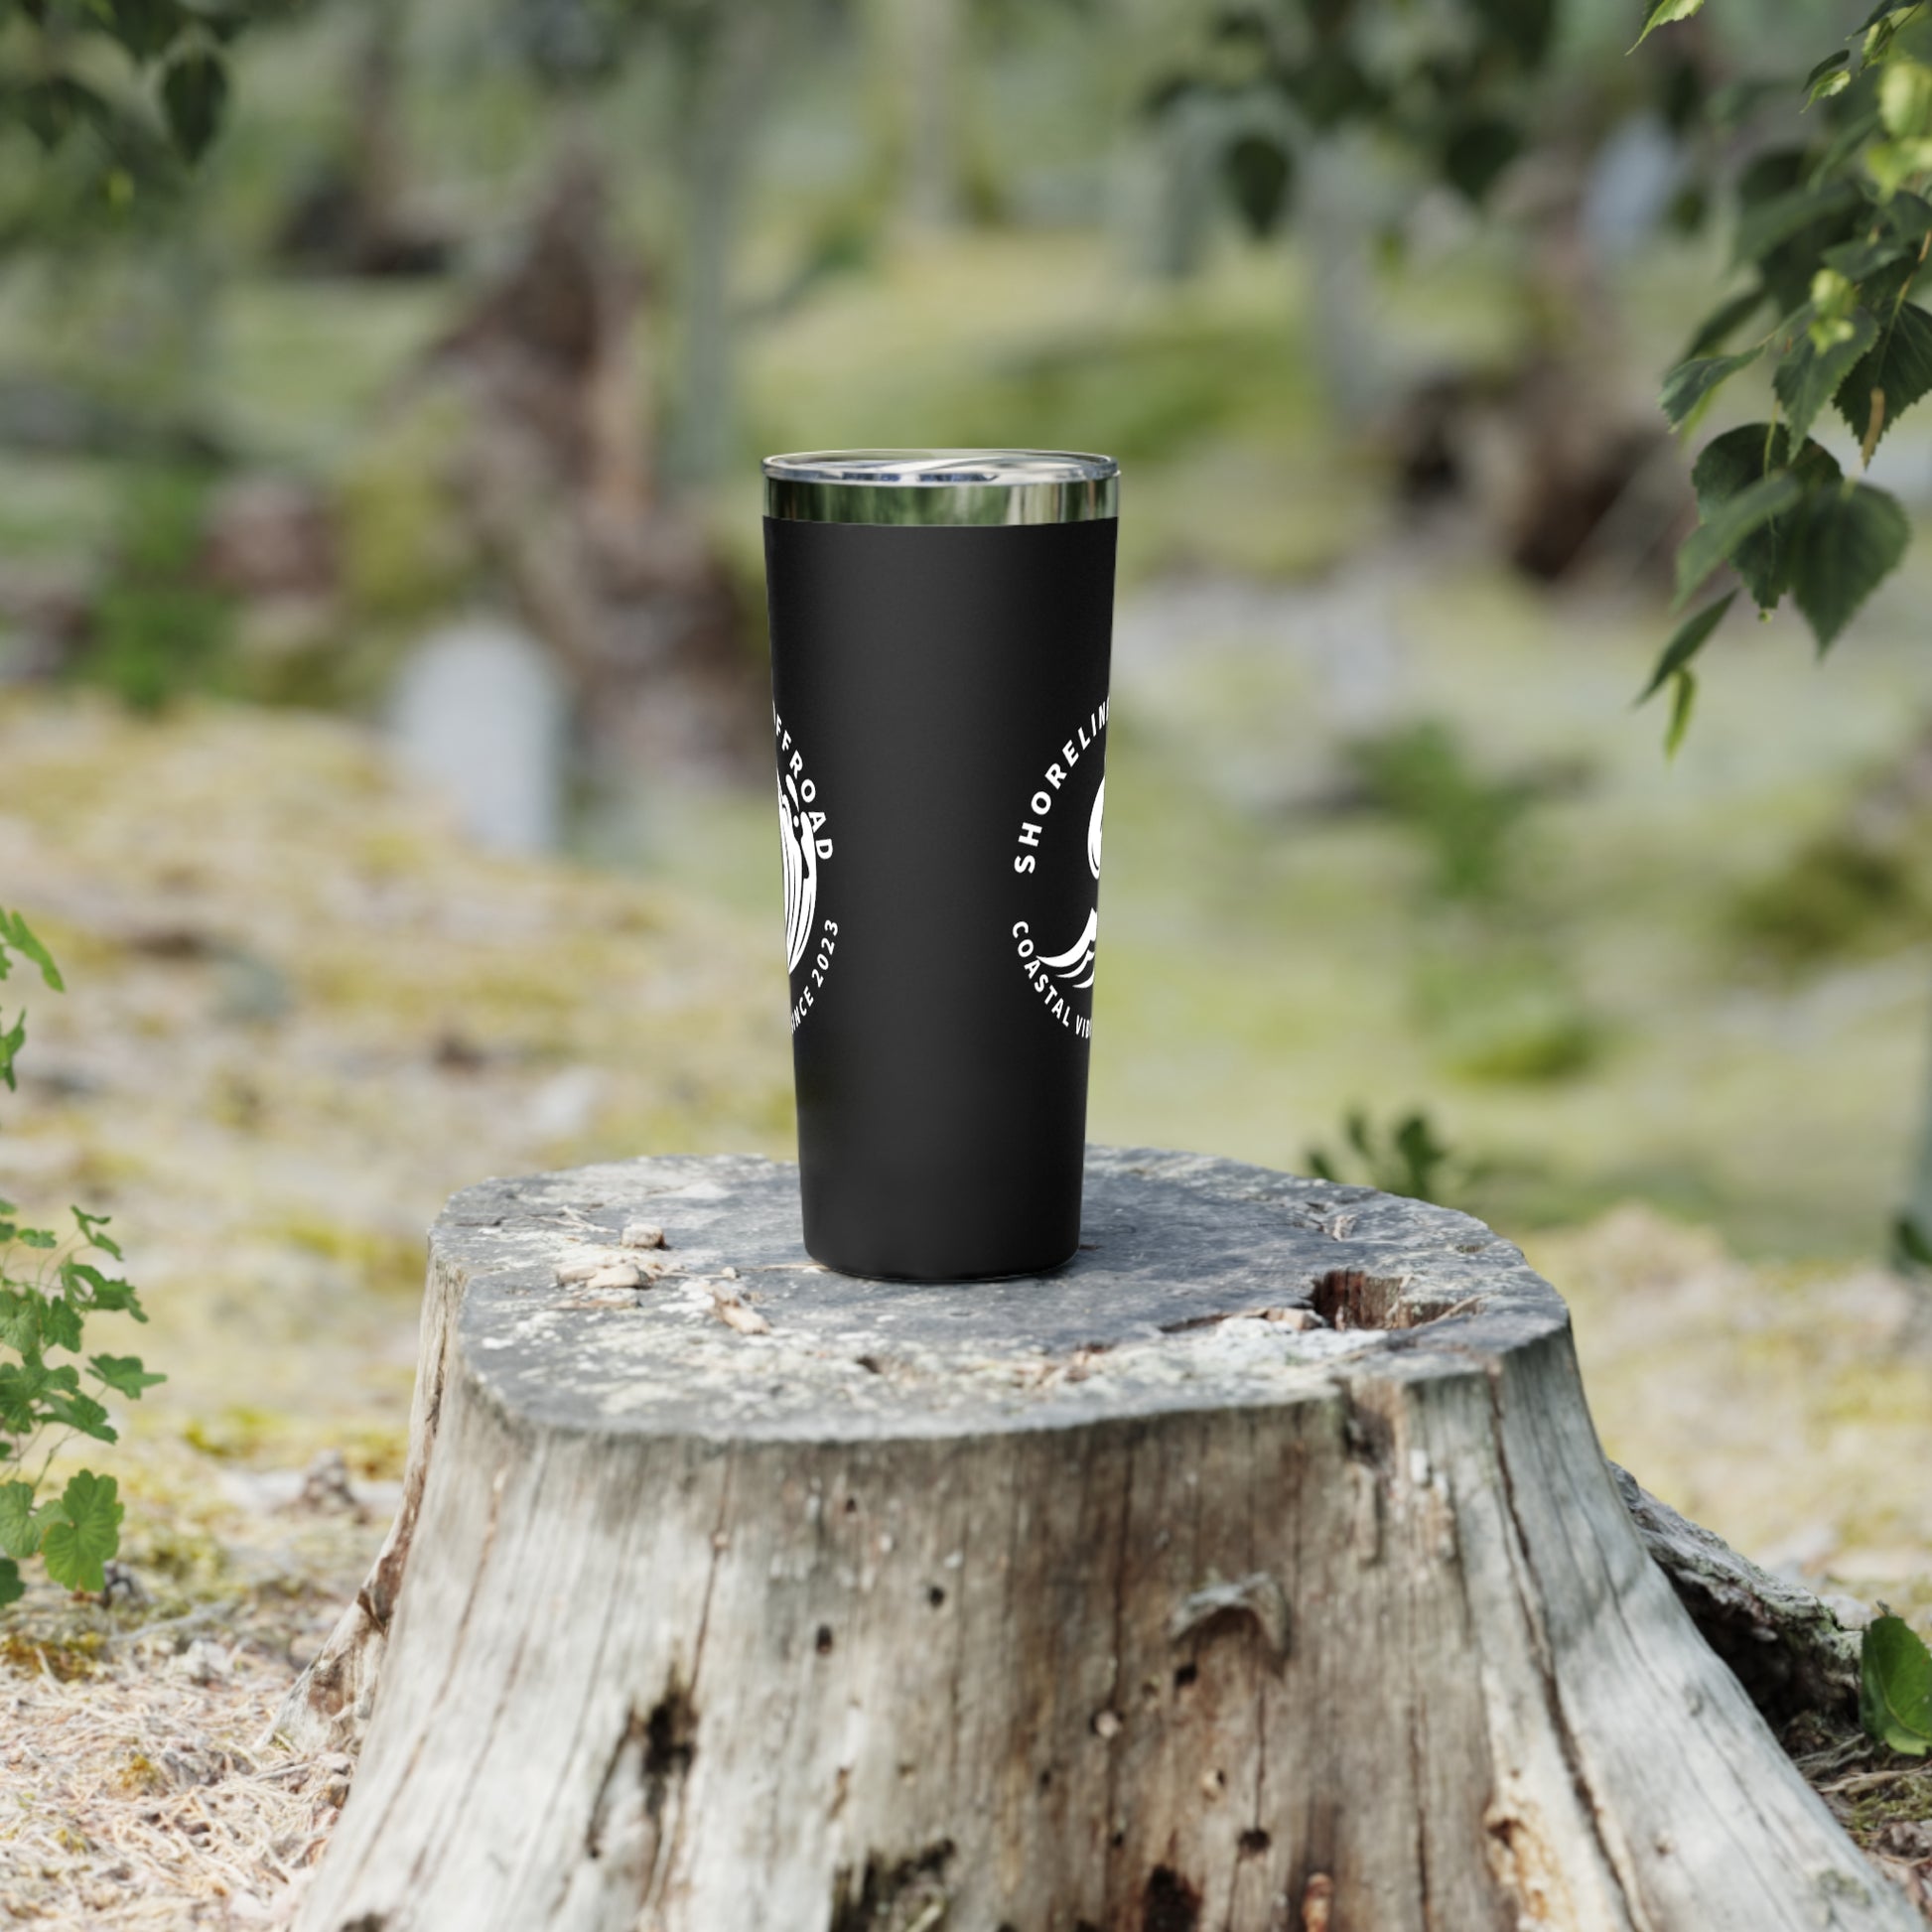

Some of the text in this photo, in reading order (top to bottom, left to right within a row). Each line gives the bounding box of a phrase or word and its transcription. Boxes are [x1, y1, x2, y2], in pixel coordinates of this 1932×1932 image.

[772, 699, 834, 860] FFROAD
[790, 919, 838, 1035] INCE 2023
[1012, 920, 1070, 1028] COASTAL
